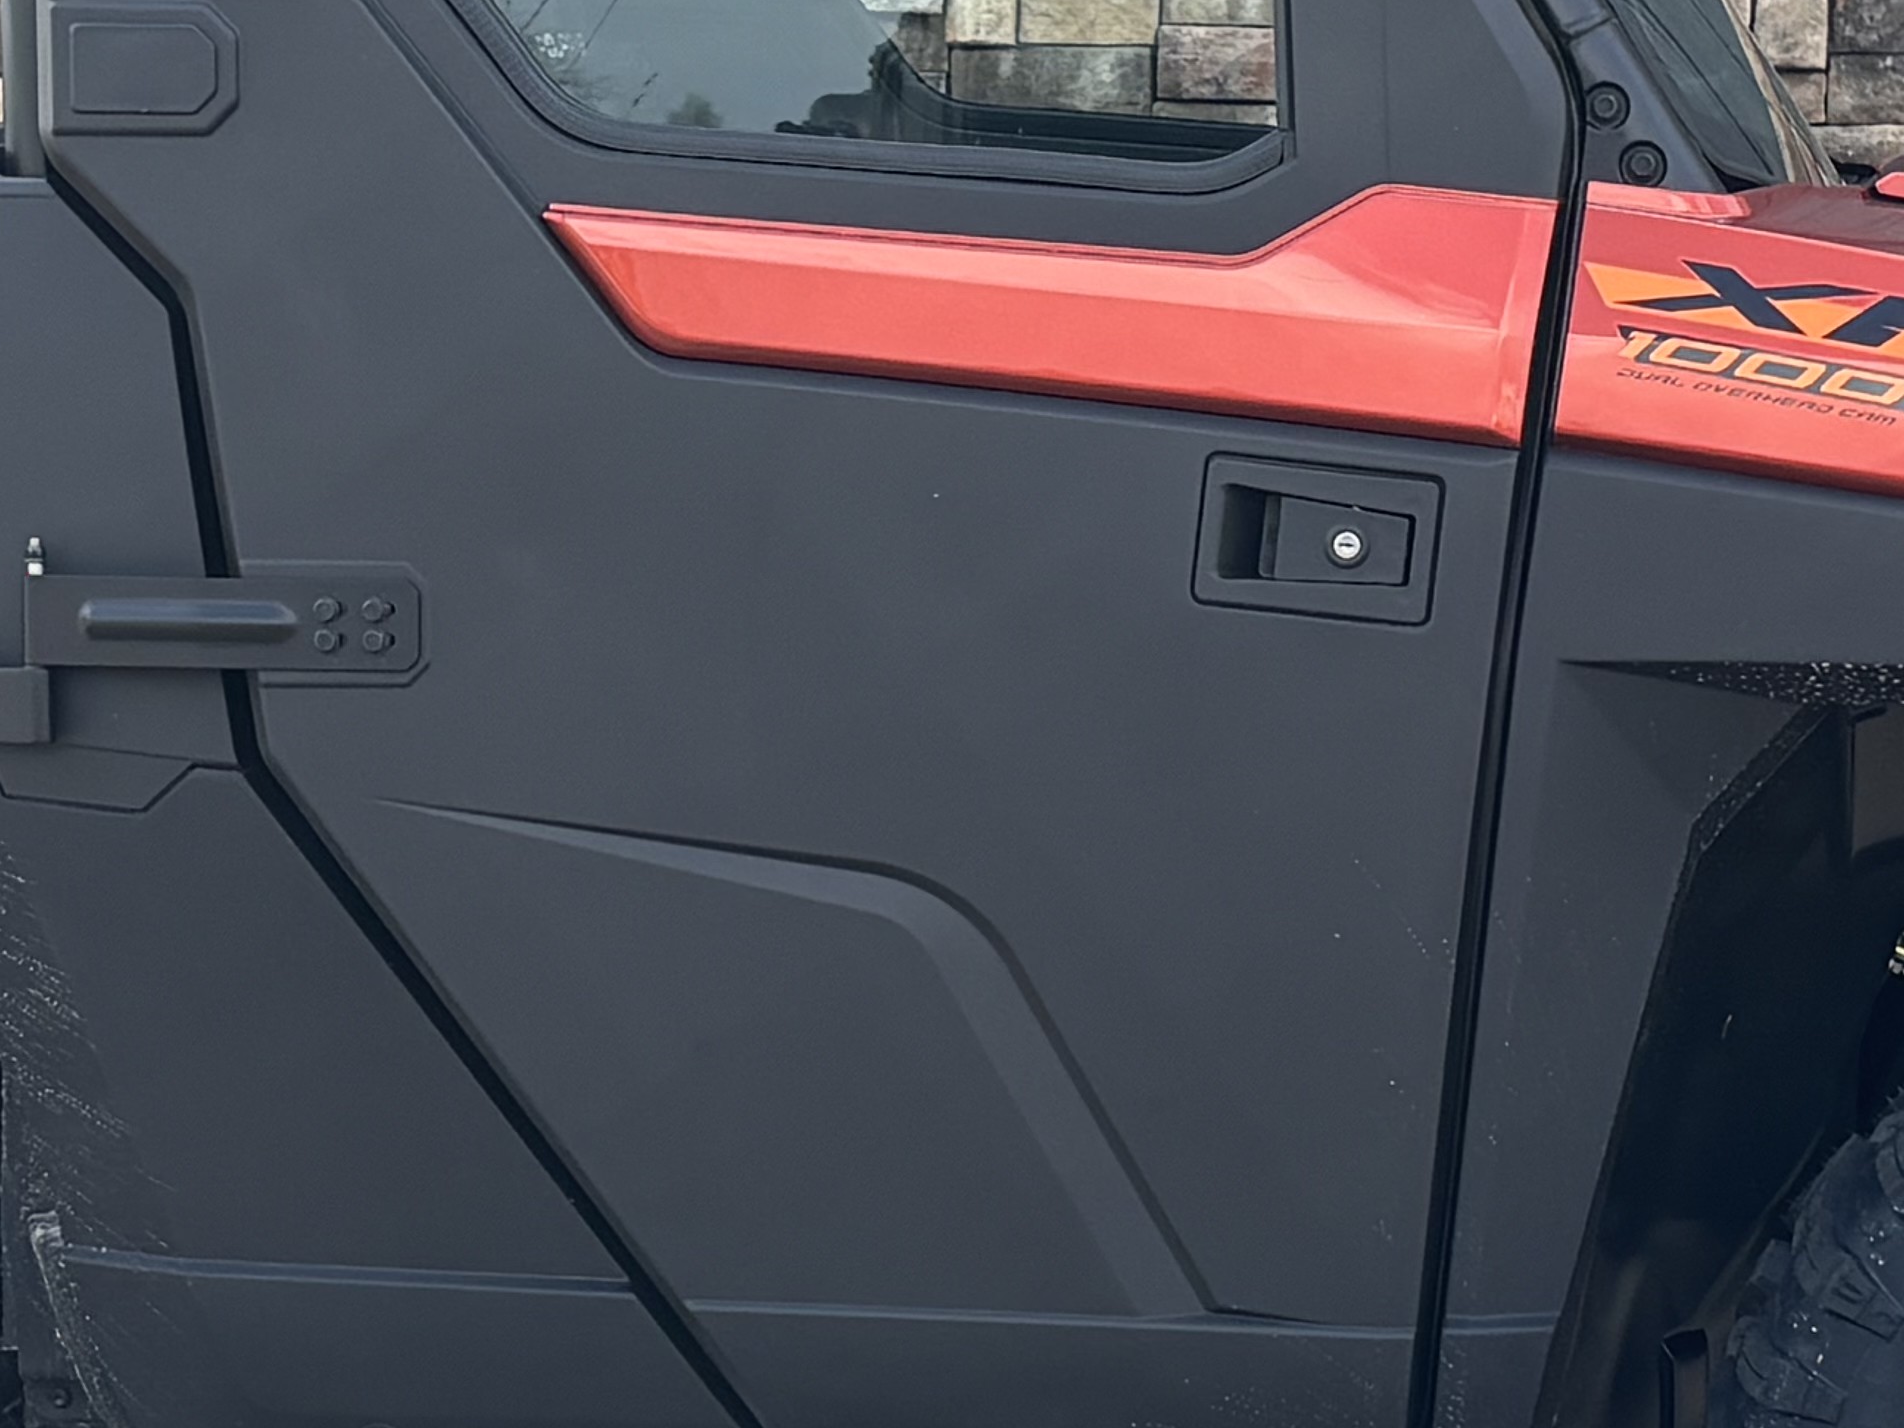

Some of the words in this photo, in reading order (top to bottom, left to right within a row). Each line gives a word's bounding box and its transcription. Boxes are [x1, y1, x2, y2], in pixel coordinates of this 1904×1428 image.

[1616, 367, 1684, 389] DUAL
[1692, 380, 1834, 414] OVERHEAD
[1838, 406, 1897, 427] CAM
